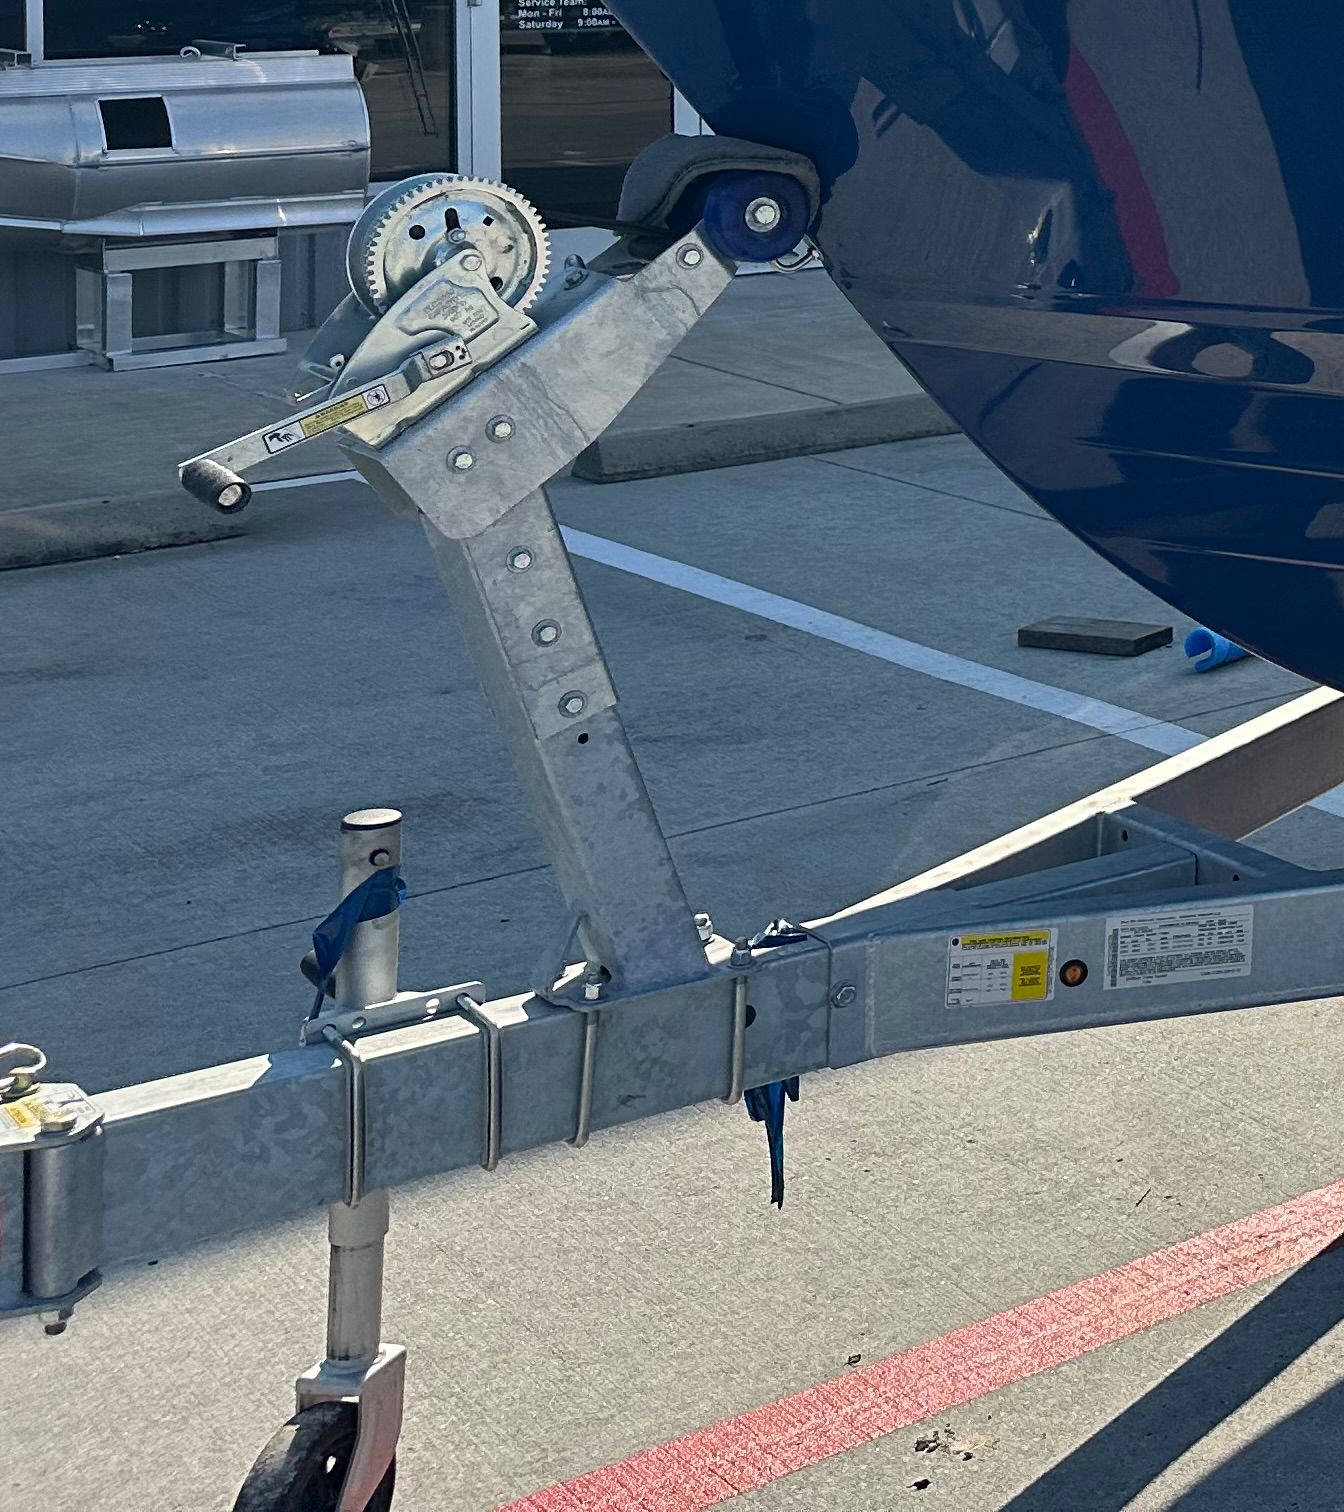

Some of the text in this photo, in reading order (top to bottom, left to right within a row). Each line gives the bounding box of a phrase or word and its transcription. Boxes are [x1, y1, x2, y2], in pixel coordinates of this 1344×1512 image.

[518, 9, 540, 18] Mon
[548, 8, 562, 18] Fri
[518, 19, 564, 29] Saturday
